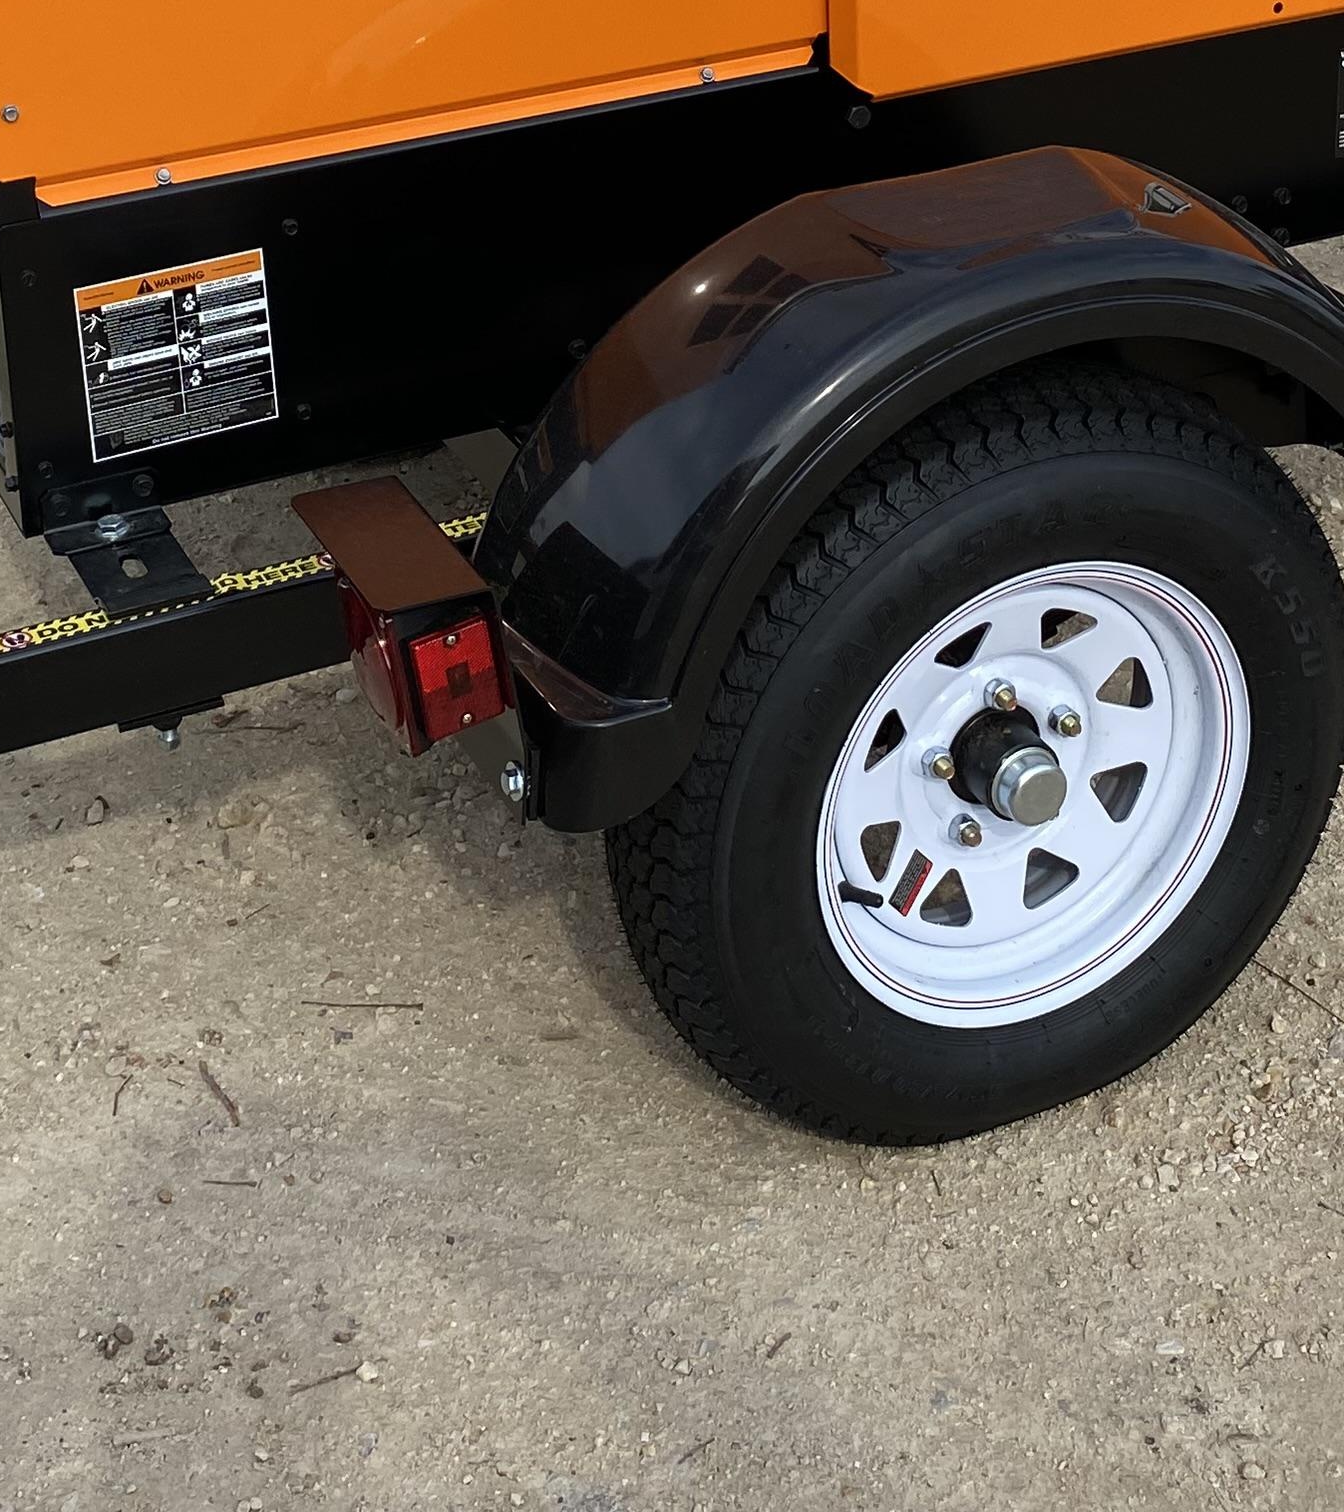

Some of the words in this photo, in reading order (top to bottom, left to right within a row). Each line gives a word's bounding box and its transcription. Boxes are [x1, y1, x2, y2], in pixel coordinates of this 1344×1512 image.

[153, 270, 205, 289] WARNING
[243, 561, 318, 586] HERE
[36, 621, 79, 639] DO
